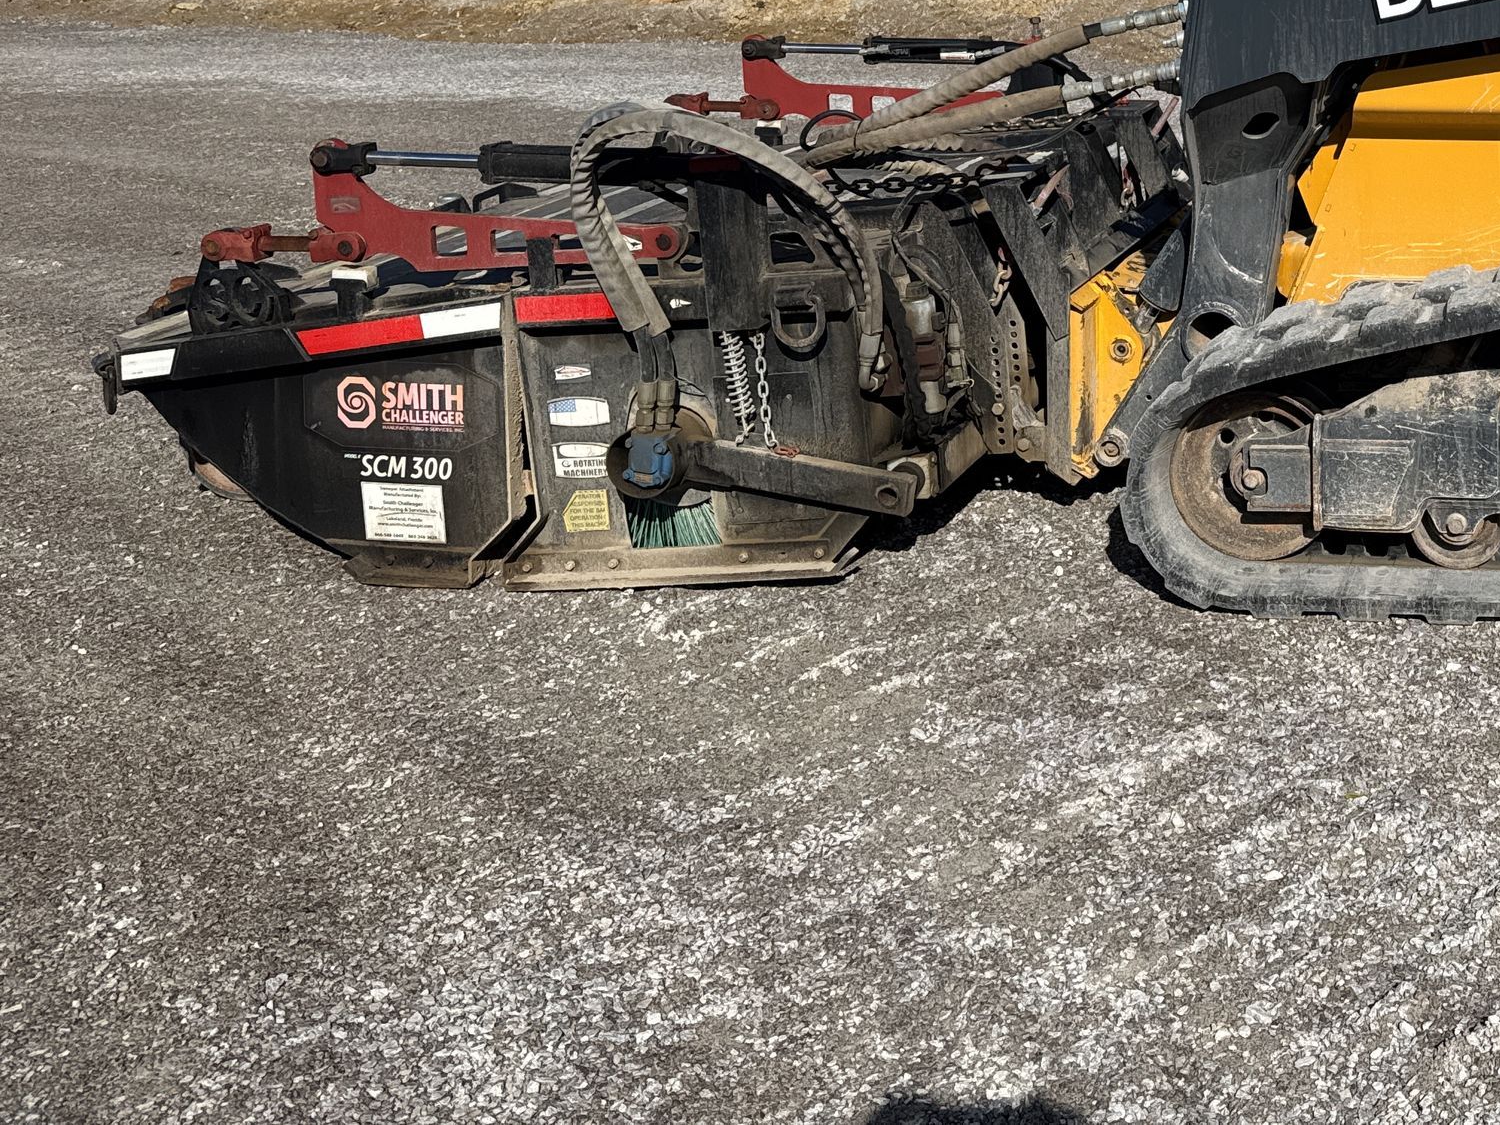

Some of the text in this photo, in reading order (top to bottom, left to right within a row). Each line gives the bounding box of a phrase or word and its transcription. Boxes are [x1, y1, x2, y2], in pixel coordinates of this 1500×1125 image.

[381, 380, 464, 411] SMITH
[381, 409, 464, 424] CHALLENGER
[360, 454, 407, 478] SCM
[410, 456, 453, 480] 300
